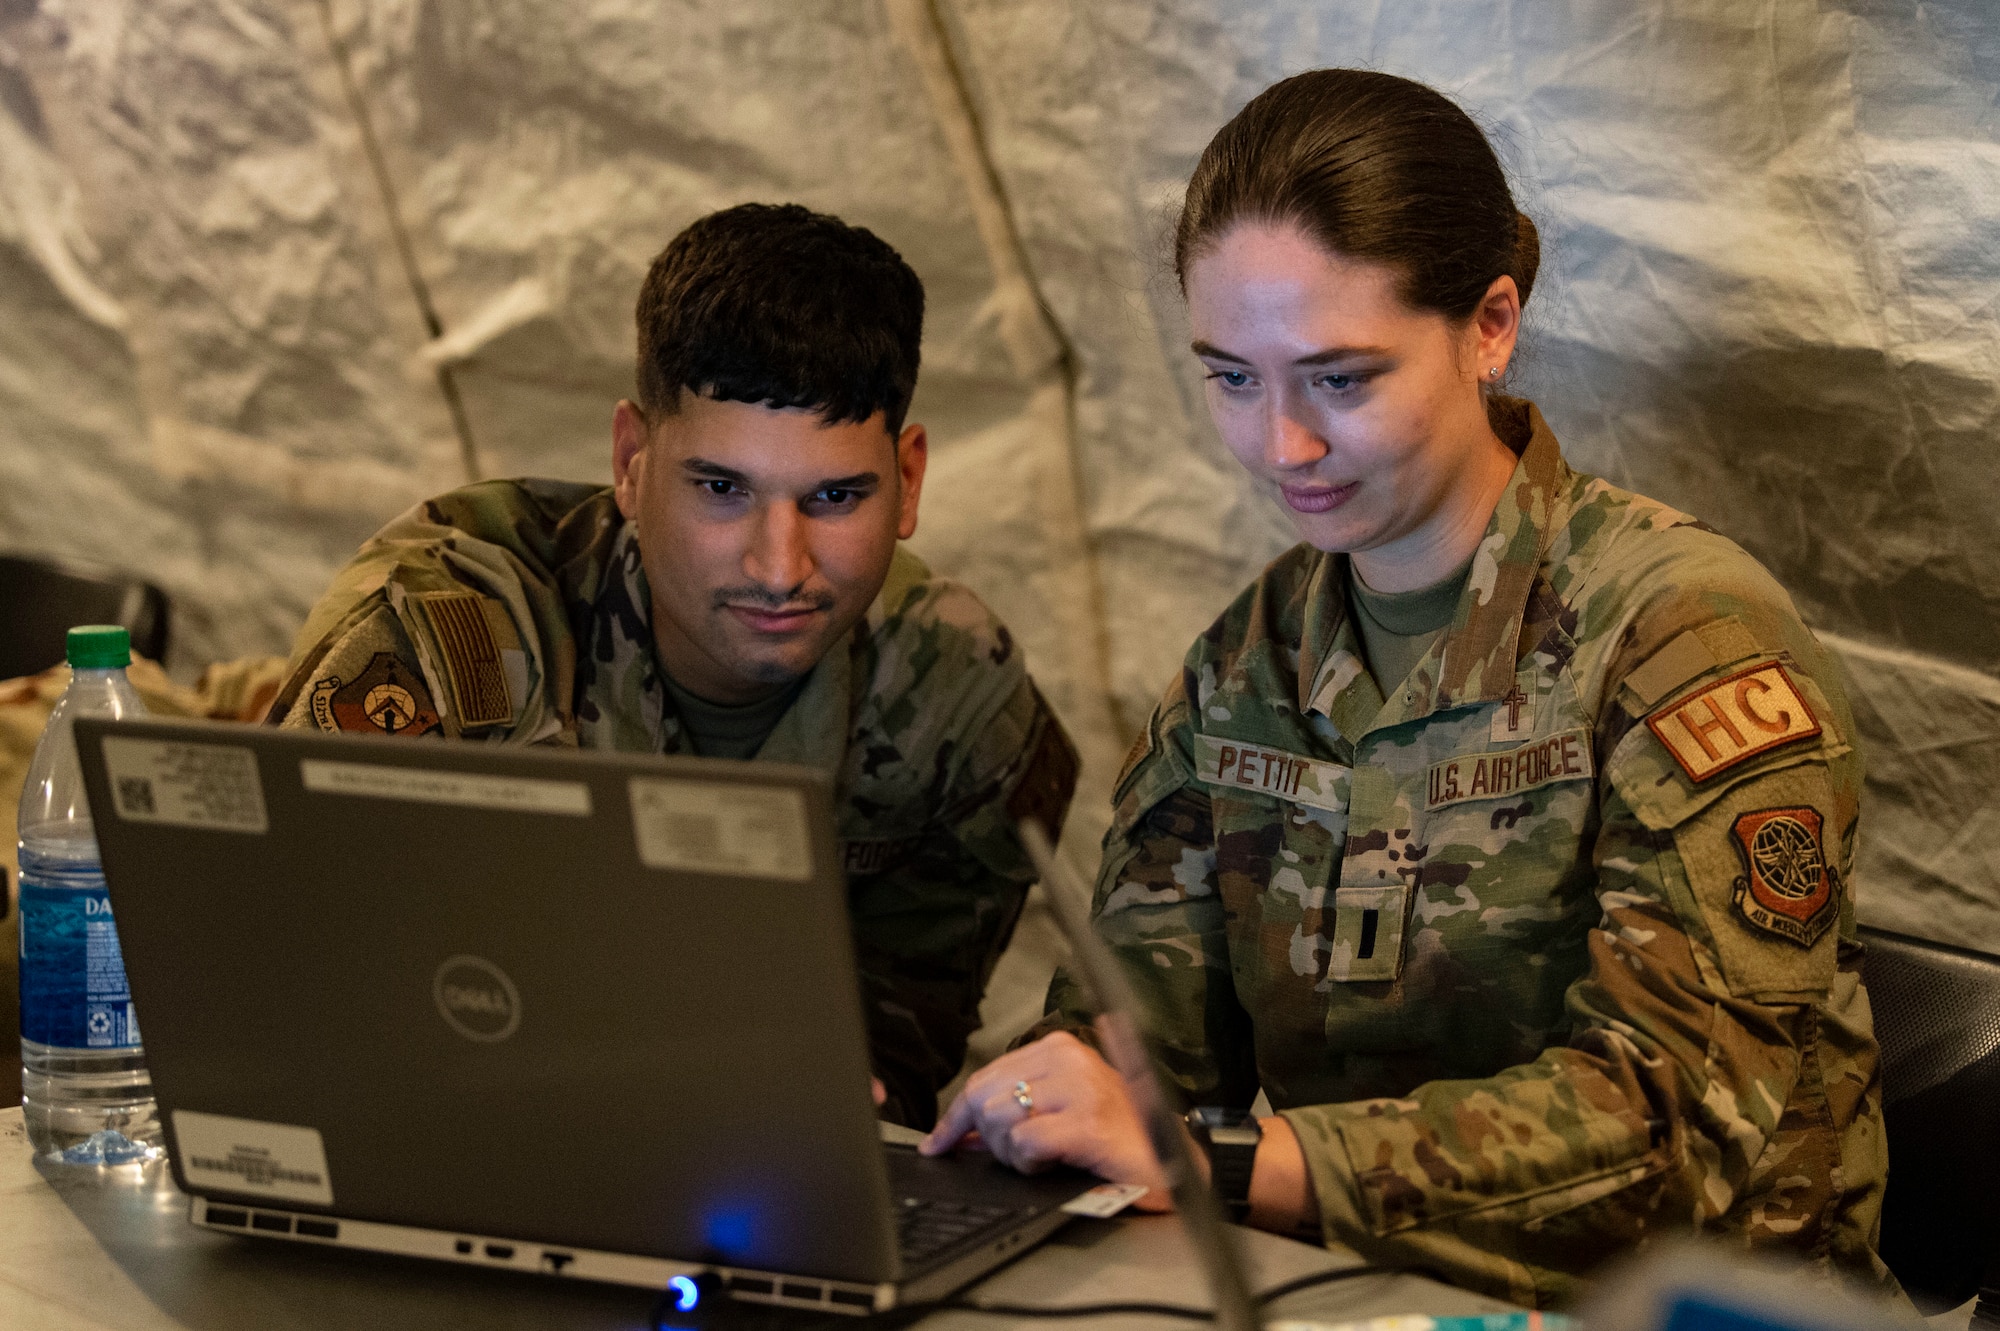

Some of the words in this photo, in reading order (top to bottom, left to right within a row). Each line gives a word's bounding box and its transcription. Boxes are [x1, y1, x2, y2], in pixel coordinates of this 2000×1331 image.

[1676, 678, 1790, 762] HC
[1218, 746, 1310, 795] PETTIT
[1429, 763, 1464, 805] U.S.
[1471, 756, 1513, 796] AIR
[1515, 736, 1582, 788] FORCE
[1752, 909, 1768, 926] AIR
